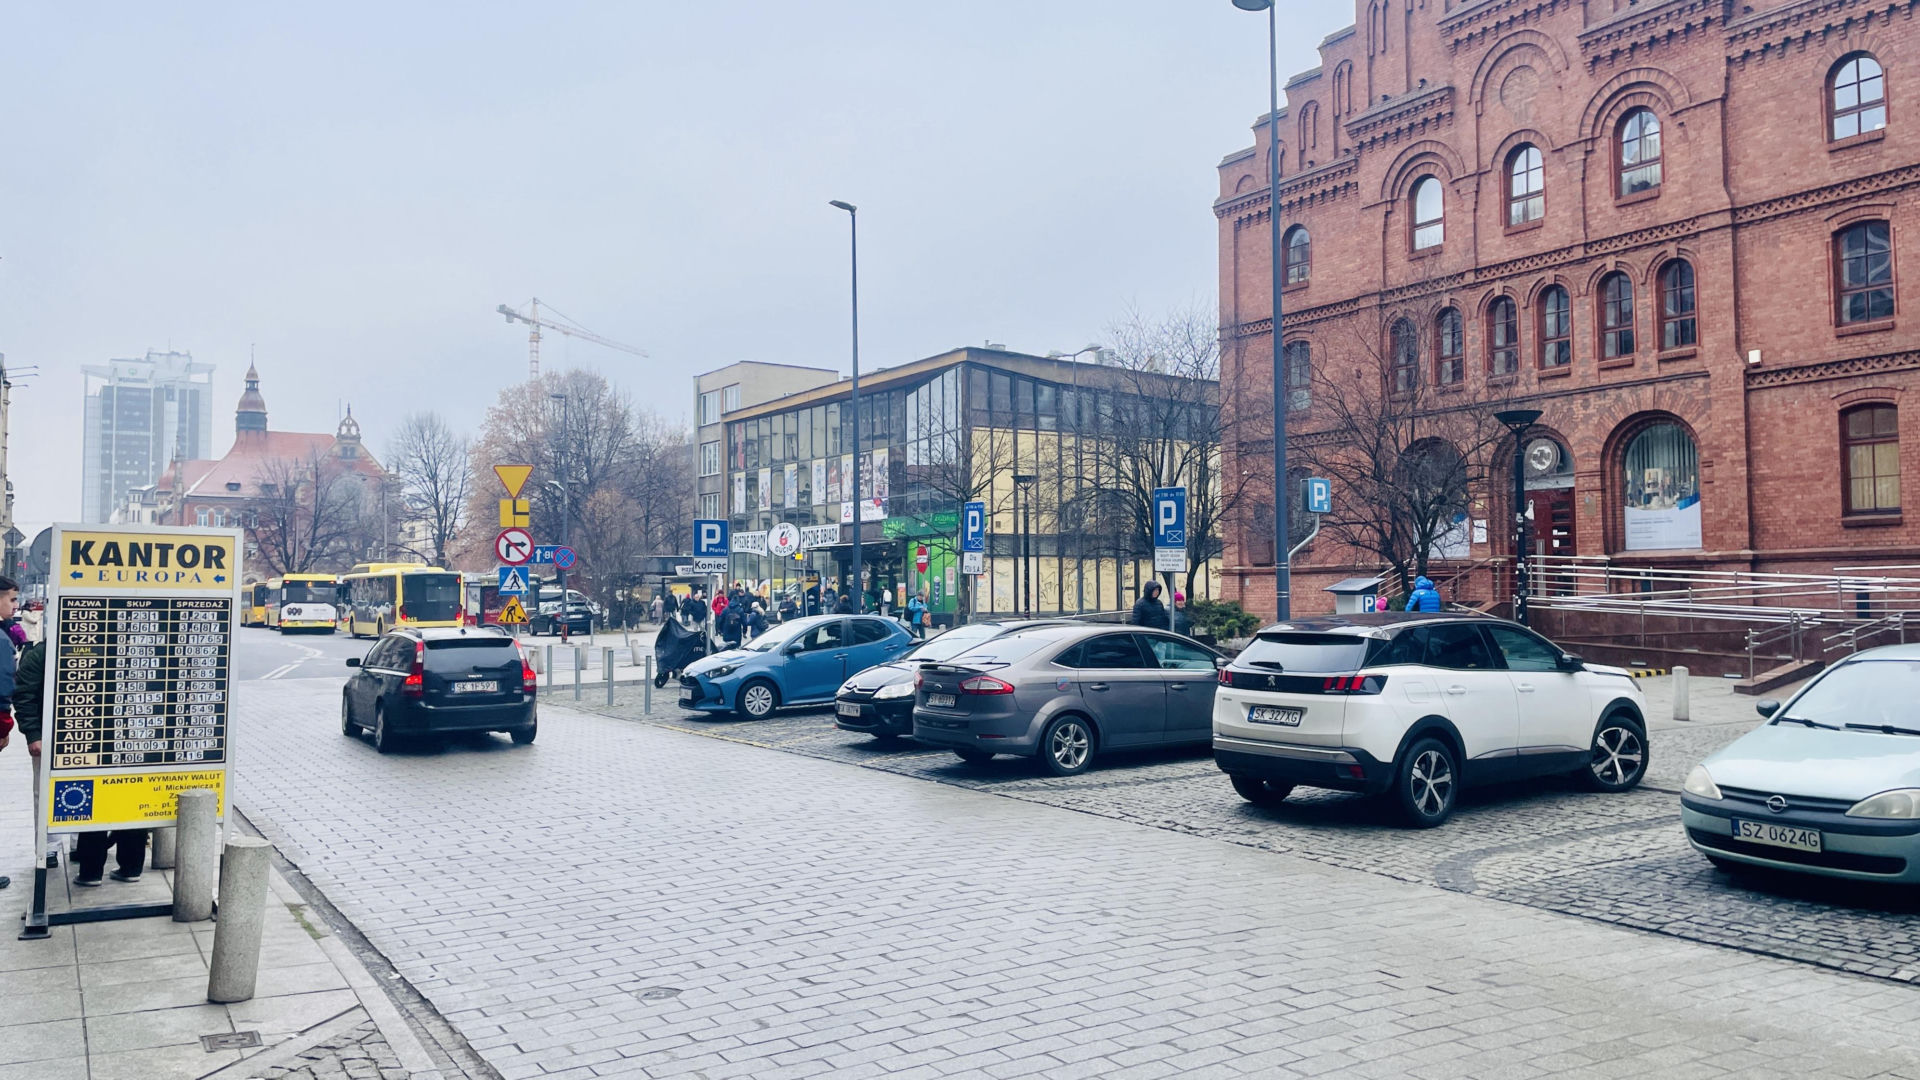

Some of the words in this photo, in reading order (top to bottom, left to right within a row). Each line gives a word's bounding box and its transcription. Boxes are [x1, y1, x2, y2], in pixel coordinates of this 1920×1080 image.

[1313, 482, 1327, 508] P
[1159, 500, 1177, 536] P
[967, 510, 980, 541] P
[701, 523, 721, 553] P
[70, 540, 226, 570] KANTOR
[694, 560, 728, 570] Koniec
[98, 570, 203, 583] EUROPA
[126, 600, 152, 608] SKUP
[176, 600, 224, 608] SPRZEDAŻ
[1364, 596, 1374, 612] P
[69, 611, 98, 620] EUR
[69, 623, 98, 632] USD
[68, 635, 98, 644] CZK
[67, 659, 97, 668] GBP
[67, 671, 96, 680] CHF
[66, 683, 96, 692] CAD
[65, 695, 95, 705] NOK
[65, 707, 95, 717] DKK
[1254, 708, 1267, 719] SK
[1269, 709, 1298, 723] 327XG
[65, 719, 93, 729] SEK
[64, 732, 95, 741] AUD
[64, 744, 92, 753] HUF
[63, 756, 90, 766] BGL
[102, 776, 143, 785] KANTOR
[148, 774, 189, 783] WYMIANY
[191, 773, 221, 781] WALUT
[165, 783, 214, 792] Mickiewicza
[144, 810, 172, 818] sobota
[1741, 822, 1764, 840] SZ
[1769, 826, 1818, 847] 0624G
